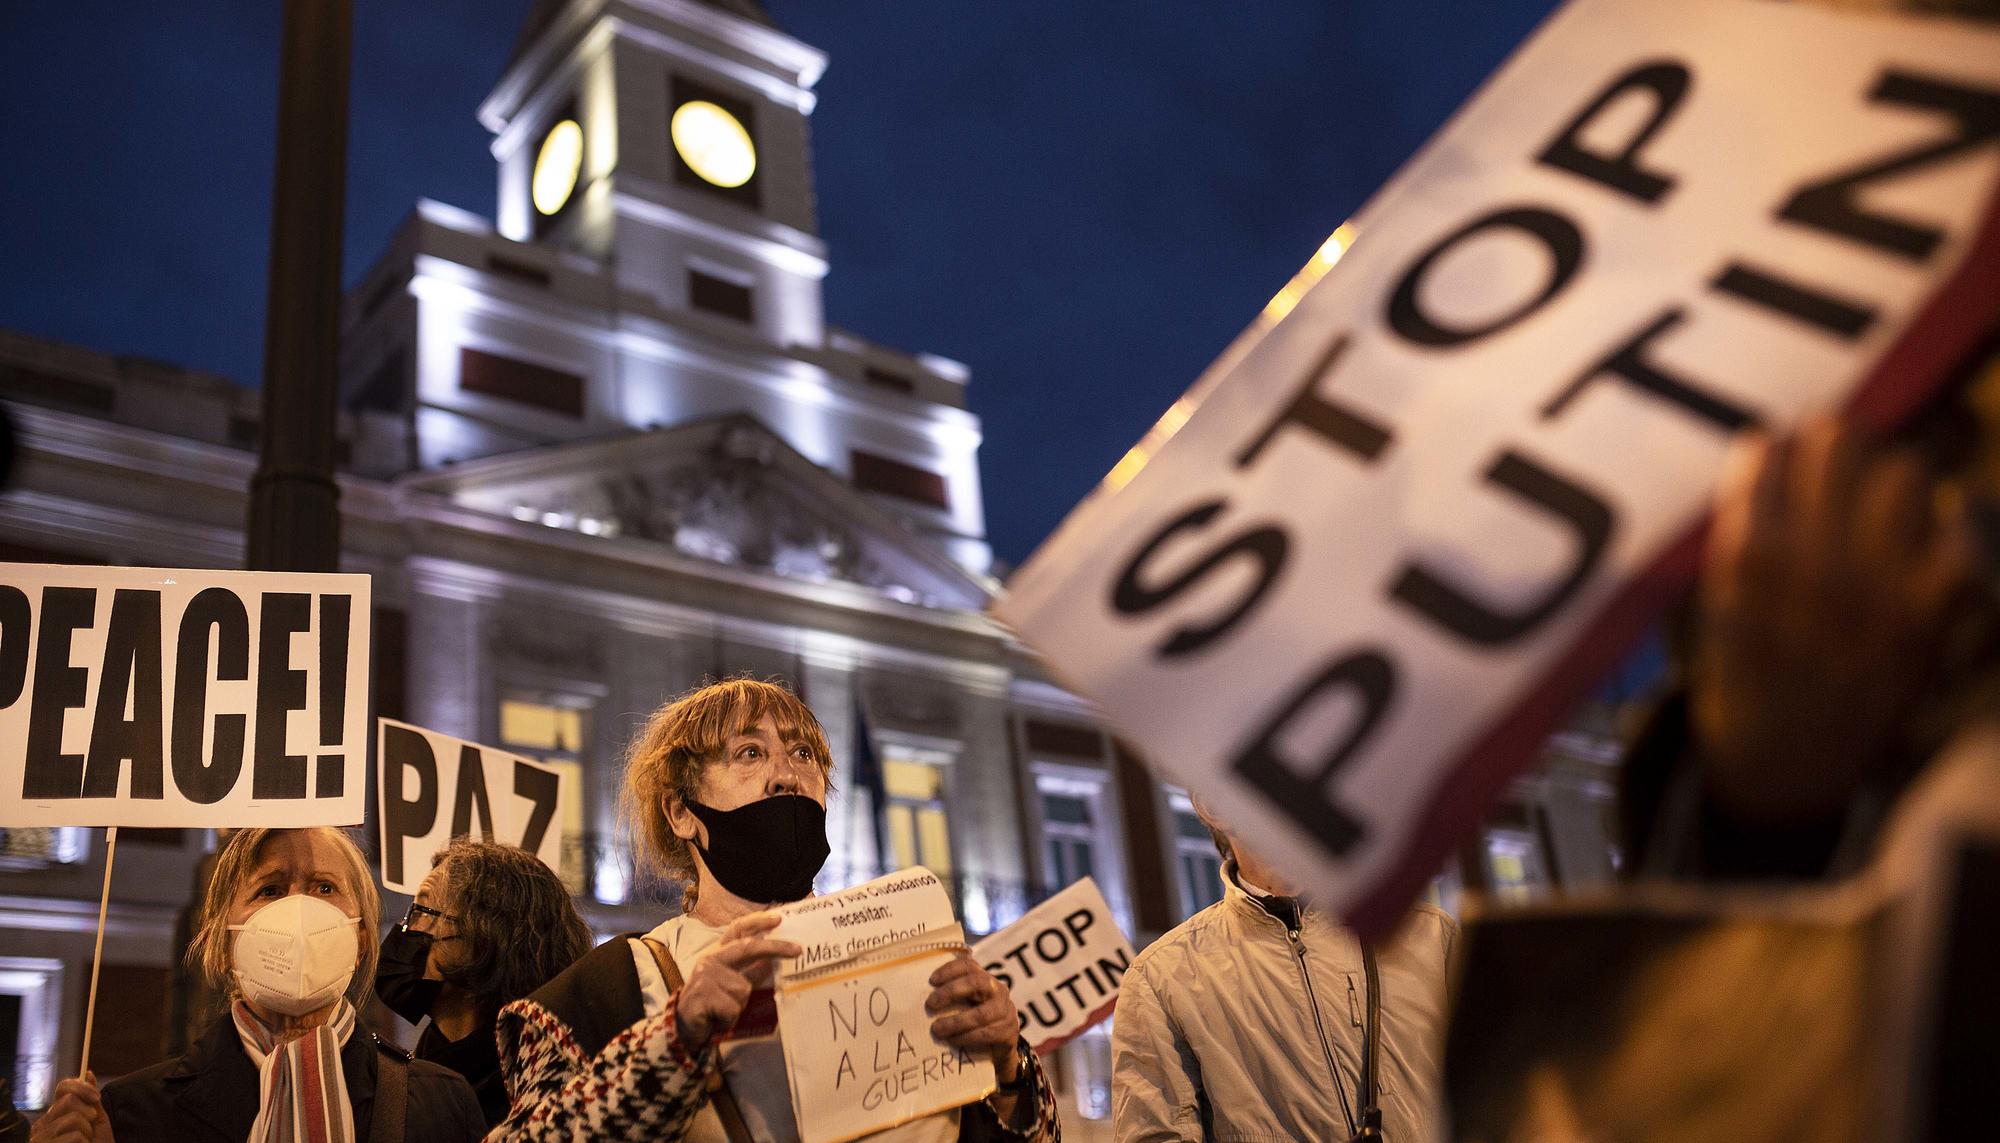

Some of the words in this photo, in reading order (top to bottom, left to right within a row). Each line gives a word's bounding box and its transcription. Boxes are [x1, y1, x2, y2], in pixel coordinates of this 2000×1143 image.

[1107, 56, 1694, 662] STOP
[1228, 64, 2000, 862] PUTIN
[384, 724, 560, 886] PAZ
[831, 904, 893, 929] necesitan:
[866, 874, 937, 898] Ciudadanos
[984, 908, 1095, 990] STOP
[836, 1050, 856, 1091] A
[873, 1029, 917, 1074] LA
[862, 1044, 976, 1111] GUERRA
